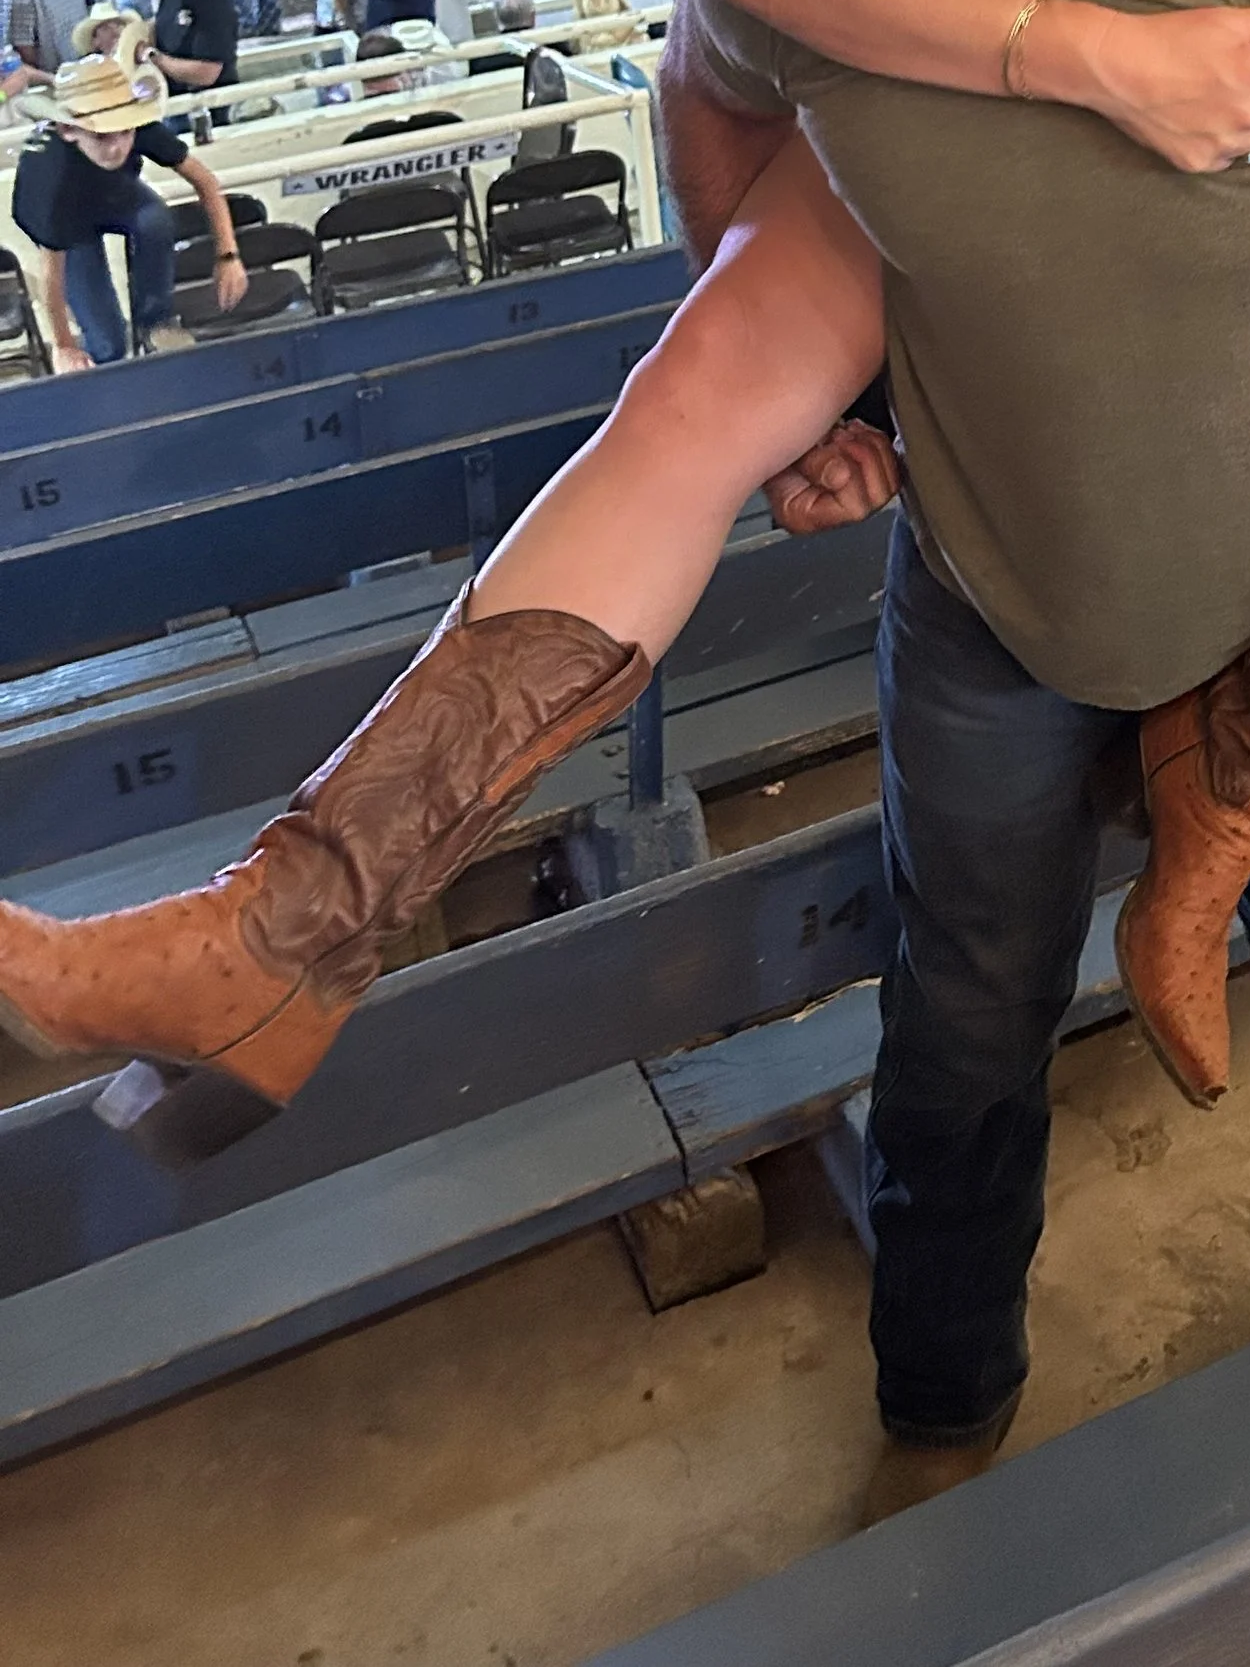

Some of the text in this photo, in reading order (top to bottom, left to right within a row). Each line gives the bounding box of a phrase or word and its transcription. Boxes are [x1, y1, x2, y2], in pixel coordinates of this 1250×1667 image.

[315, 141, 487, 192] WRANGLER
[302, 411, 342, 442] 14
[20, 477, 62, 511] 15
[113, 747, 178, 796] 15
[798, 885, 869, 950] 14
